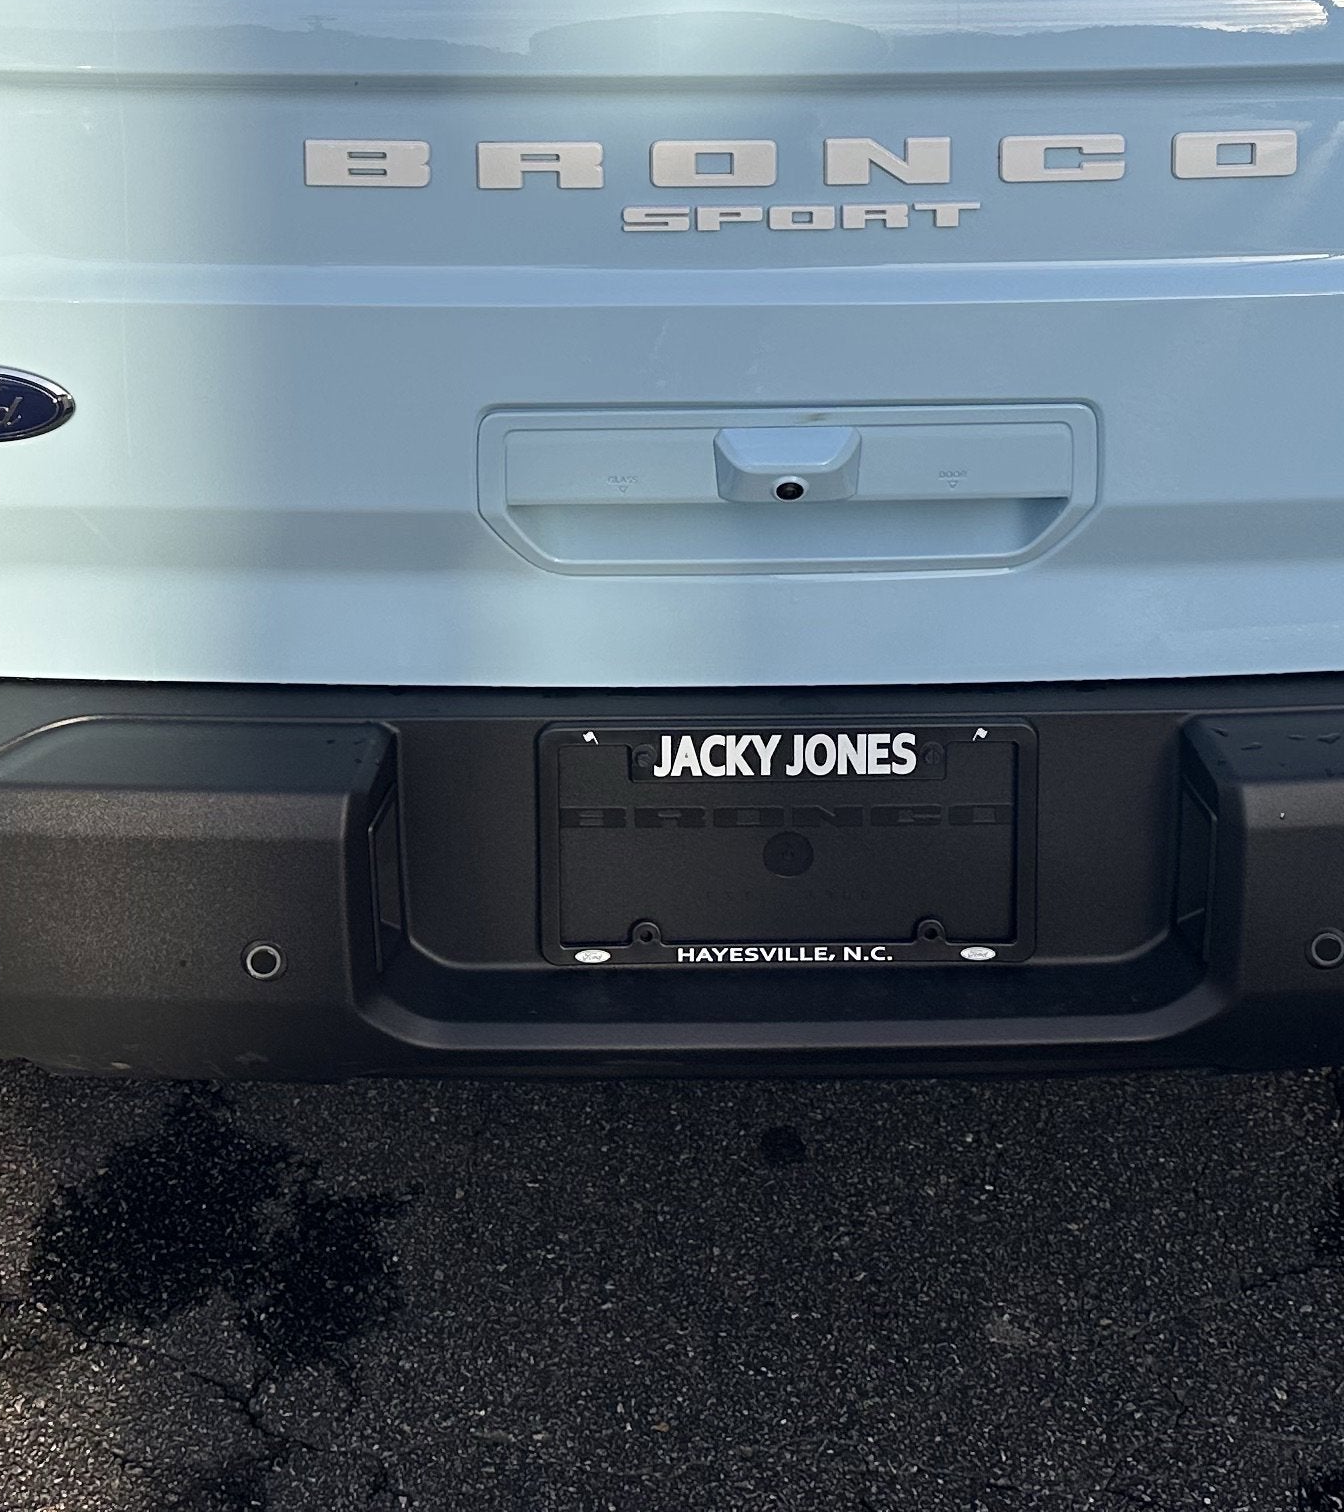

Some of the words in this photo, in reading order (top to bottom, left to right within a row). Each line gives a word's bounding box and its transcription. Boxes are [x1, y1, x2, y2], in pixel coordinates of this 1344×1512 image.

[303, 129, 1299, 190] BRONCO
[622, 202, 982, 233] SPORT
[653, 734, 781, 777] JACKY
[786, 733, 917, 776] JONES
[560, 806, 1013, 828] BRONCO
[677, 947, 836, 963] HAYESVILLE,
[843, 946, 893, 962] N.C.
